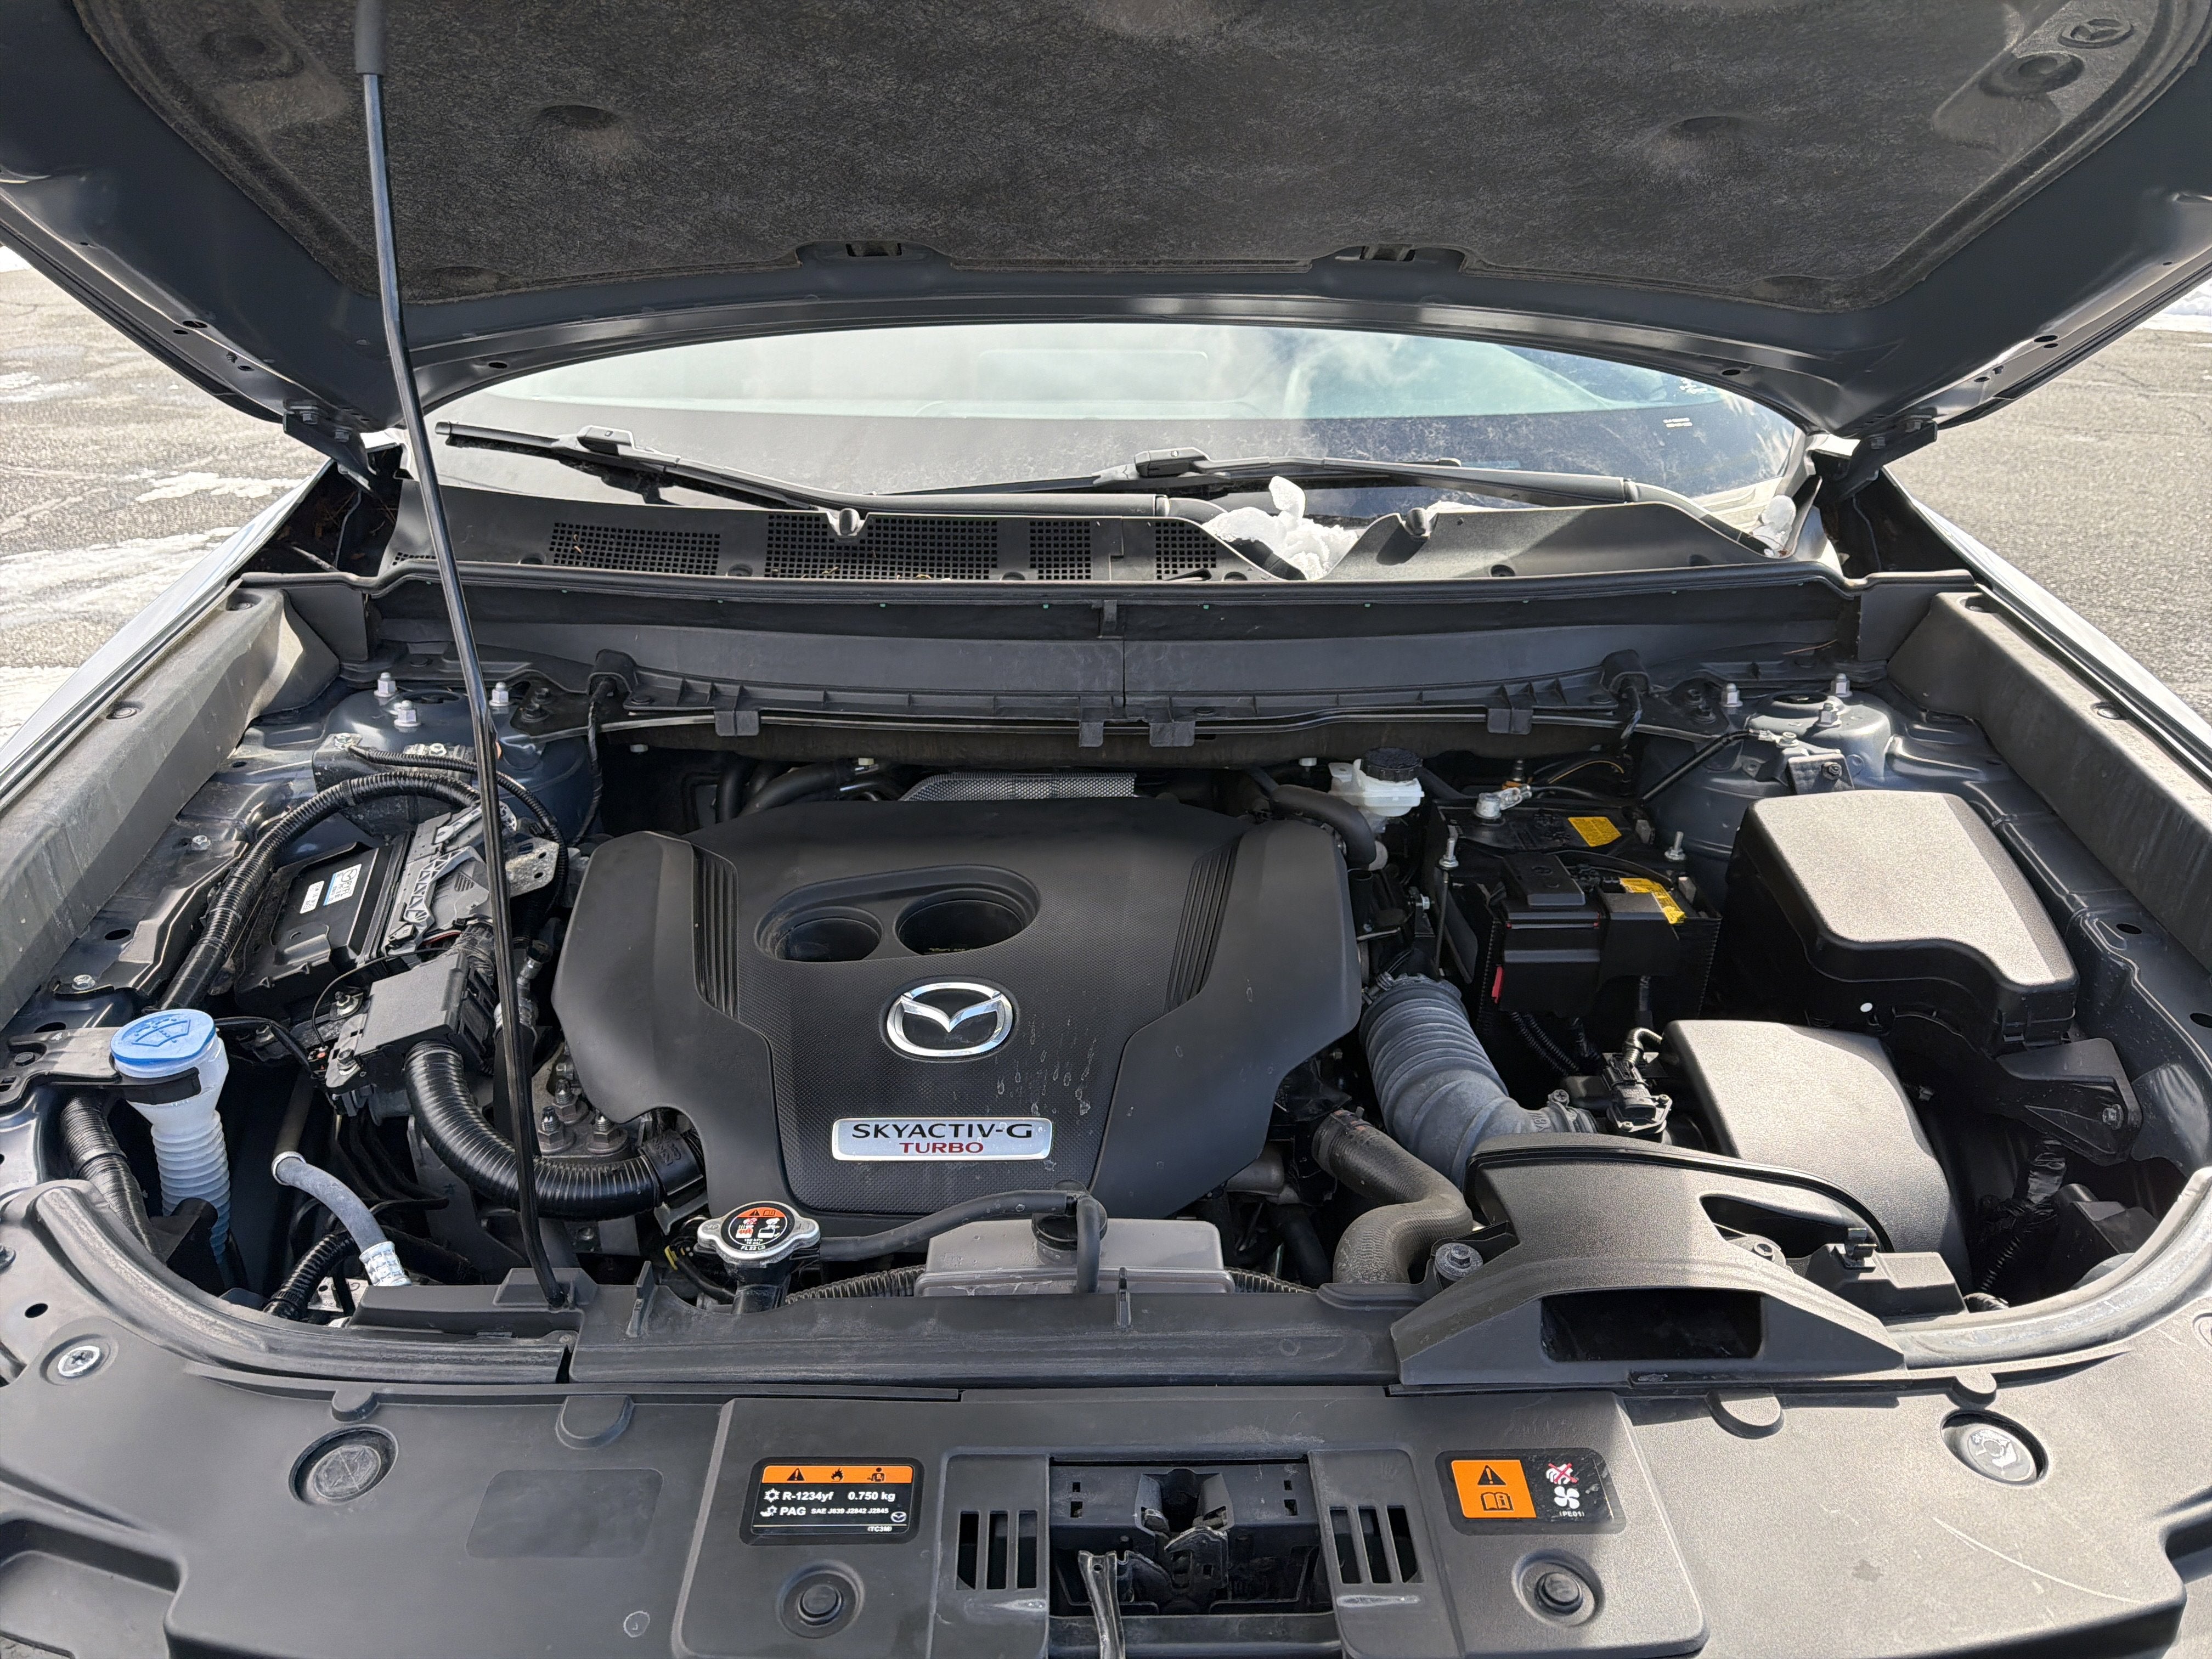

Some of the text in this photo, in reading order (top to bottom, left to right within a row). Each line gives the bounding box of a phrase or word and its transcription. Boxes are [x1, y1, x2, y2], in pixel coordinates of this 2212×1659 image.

[852, 1123, 1032, 1138] SKYACTIV-G
[899, 1142, 984, 1153] TURBO
[782, 1491, 896, 1503] R-1234yf 0.750 kg
[780, 1506, 806, 1516] PAG
